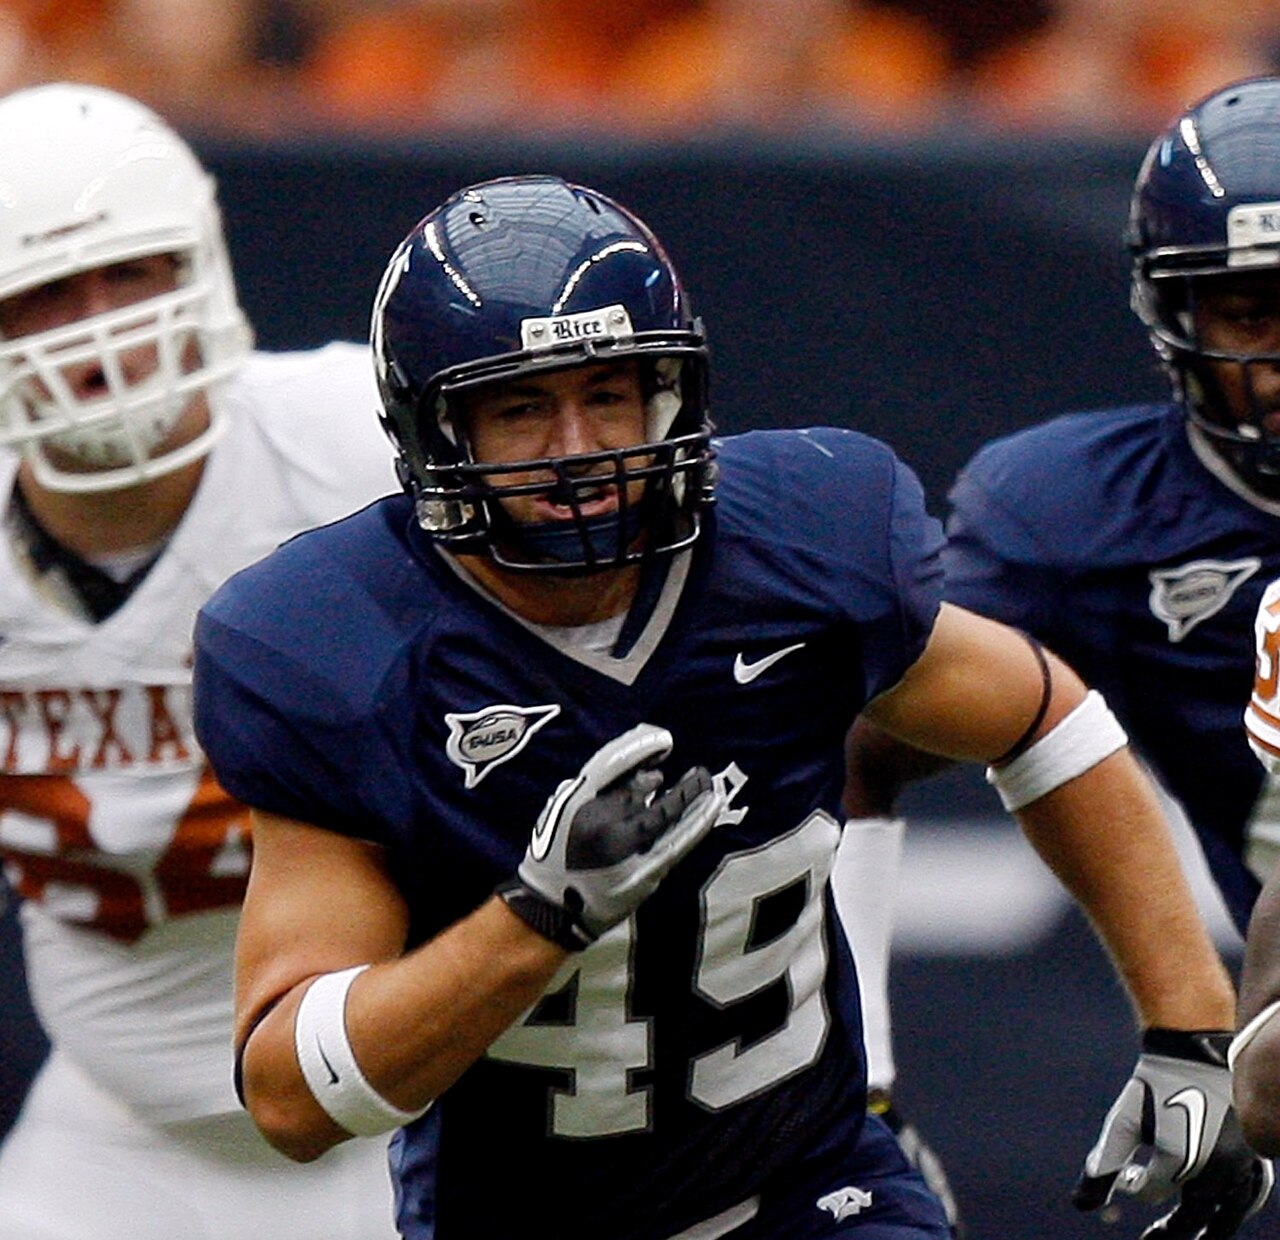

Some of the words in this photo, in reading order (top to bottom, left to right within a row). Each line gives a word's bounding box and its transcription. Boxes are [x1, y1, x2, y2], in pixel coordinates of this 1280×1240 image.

[550, 319, 601, 339] Rice
[0, 684, 190, 770] TEXA
[485, 808, 842, 1141] 49
